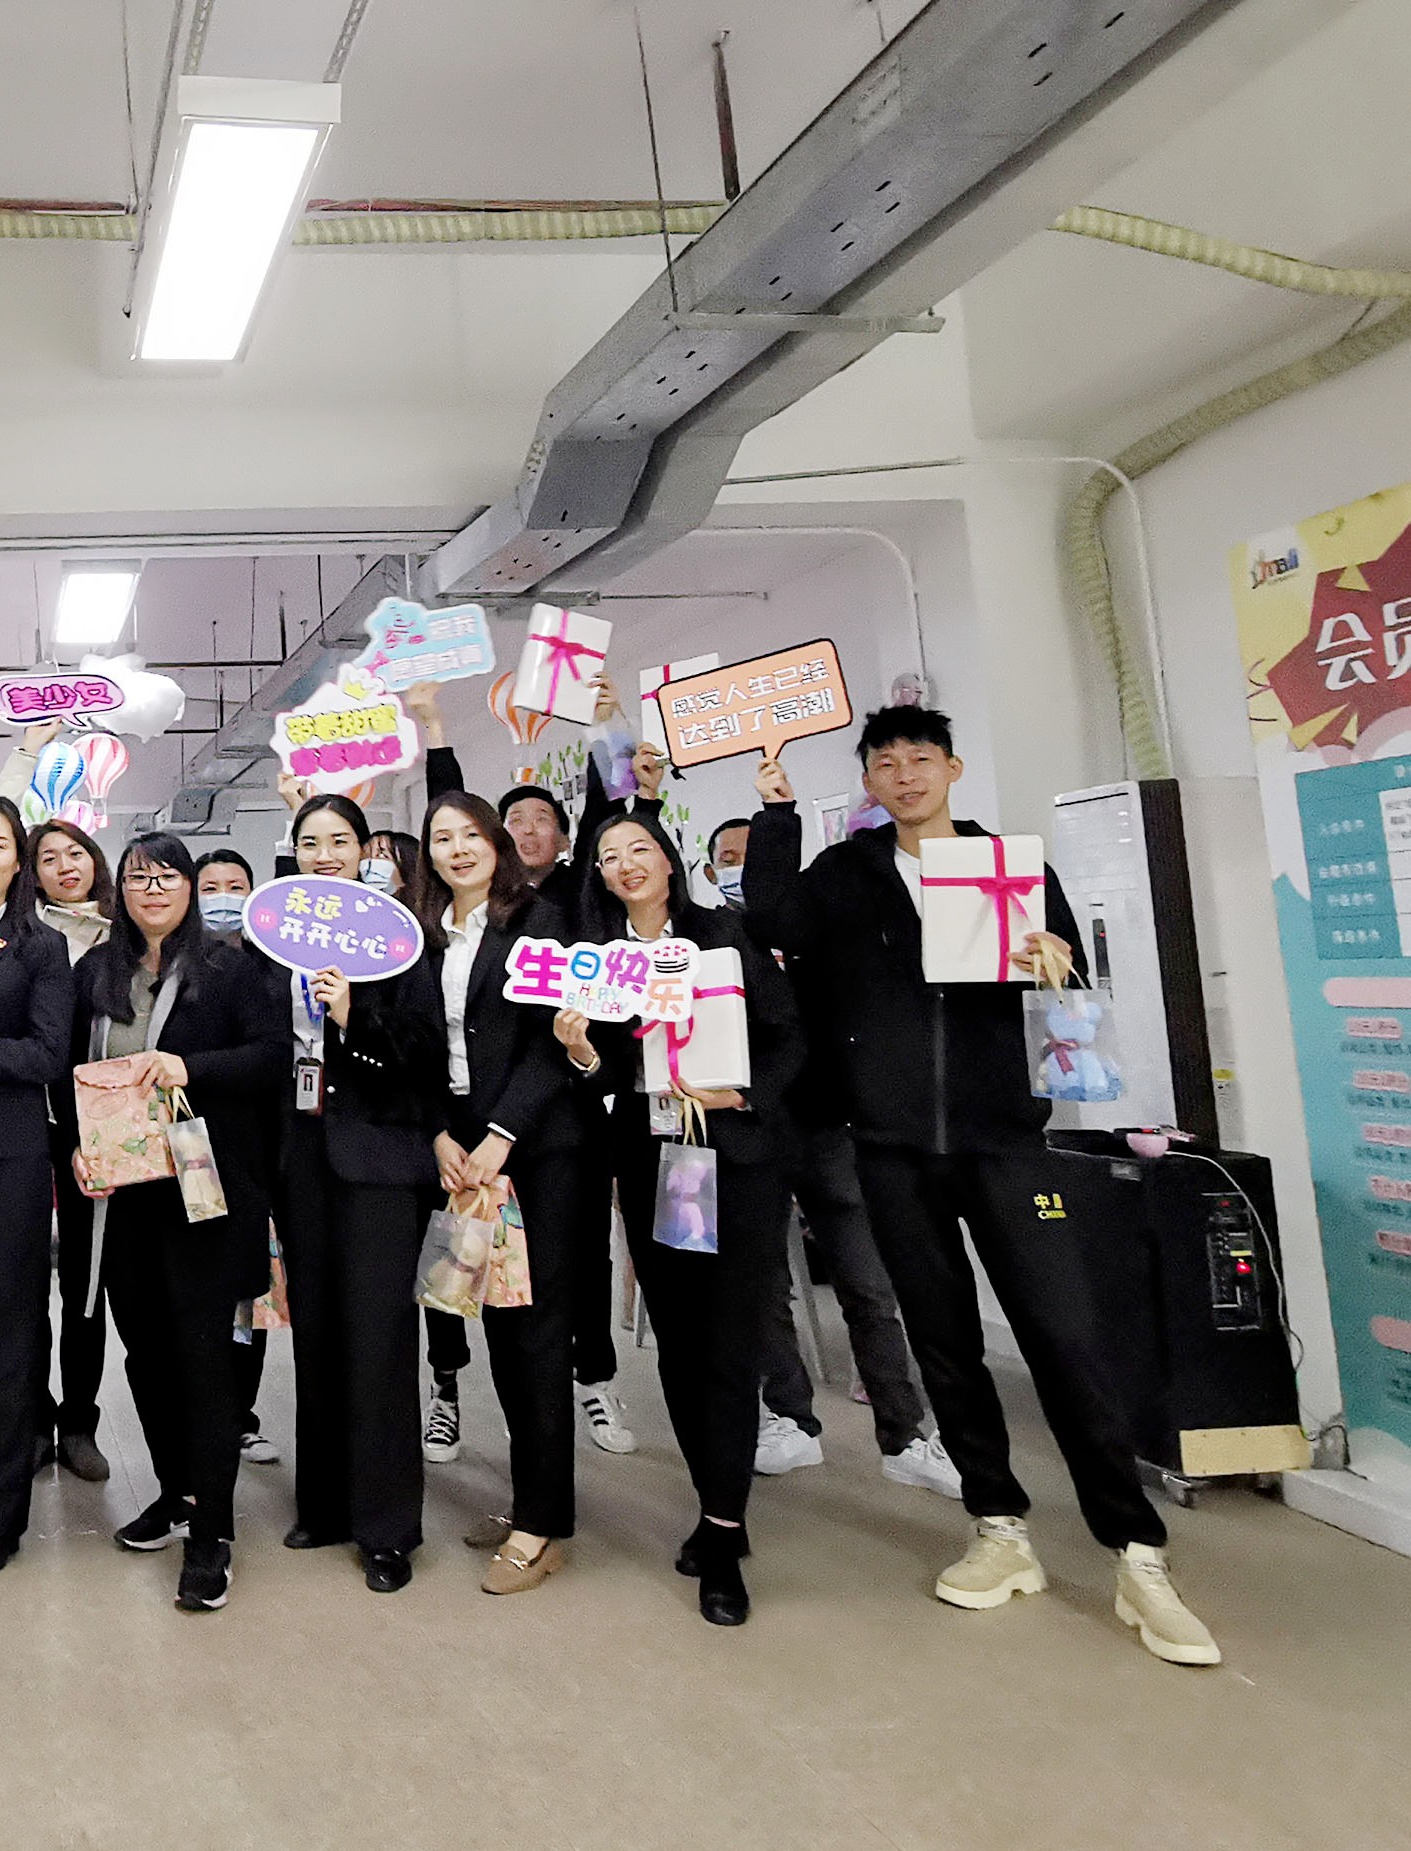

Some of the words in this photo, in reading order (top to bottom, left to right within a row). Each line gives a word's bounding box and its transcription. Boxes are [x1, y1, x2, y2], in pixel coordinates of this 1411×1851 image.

[7, 681, 114, 714] 美少女
[671, 658, 830, 719] 感觉人生已经
[677, 687, 836, 750] 达到了高潮
[285, 886, 343, 921] 永远
[279, 916, 388, 960] 开开心心
[512, 944, 685, 1015] 生日快乐
